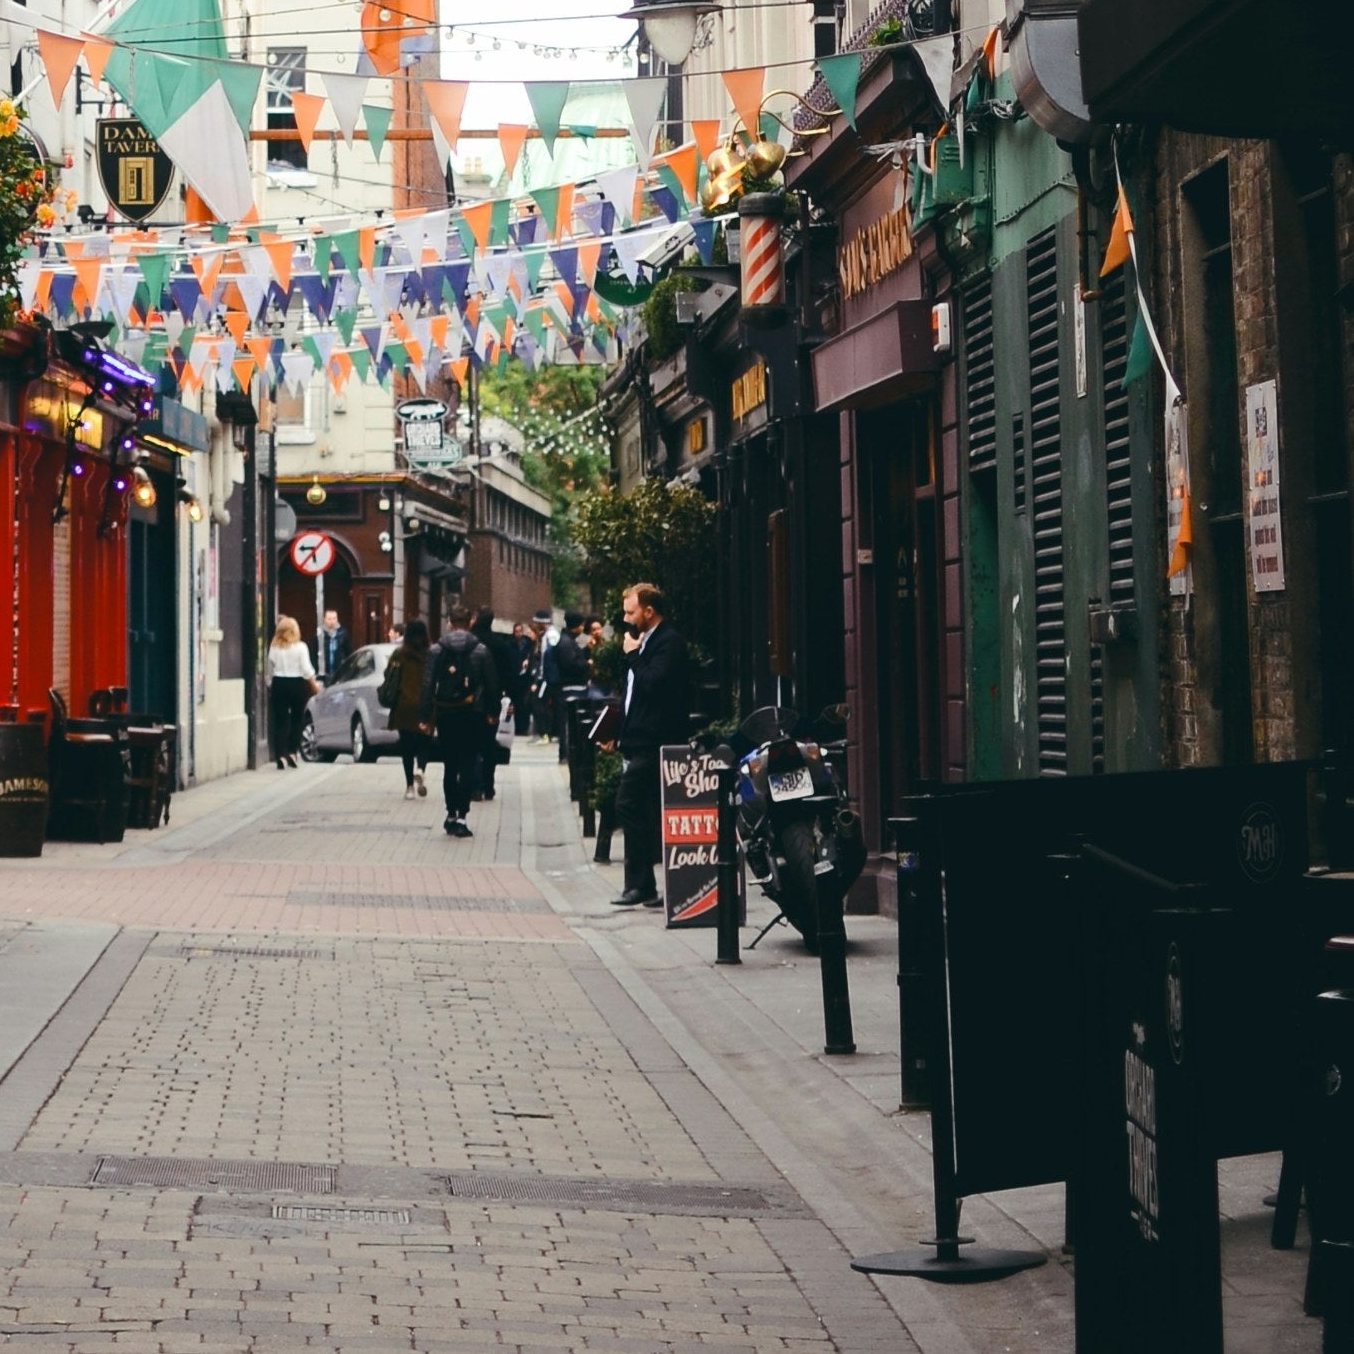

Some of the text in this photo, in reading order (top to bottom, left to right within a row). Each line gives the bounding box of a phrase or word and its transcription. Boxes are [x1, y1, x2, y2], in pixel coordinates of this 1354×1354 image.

[104, 126, 154, 140] DAM
[105, 140, 160, 154] TAVER
[684, 769, 719, 798] Sho
[667, 814, 718, 837] TATT
